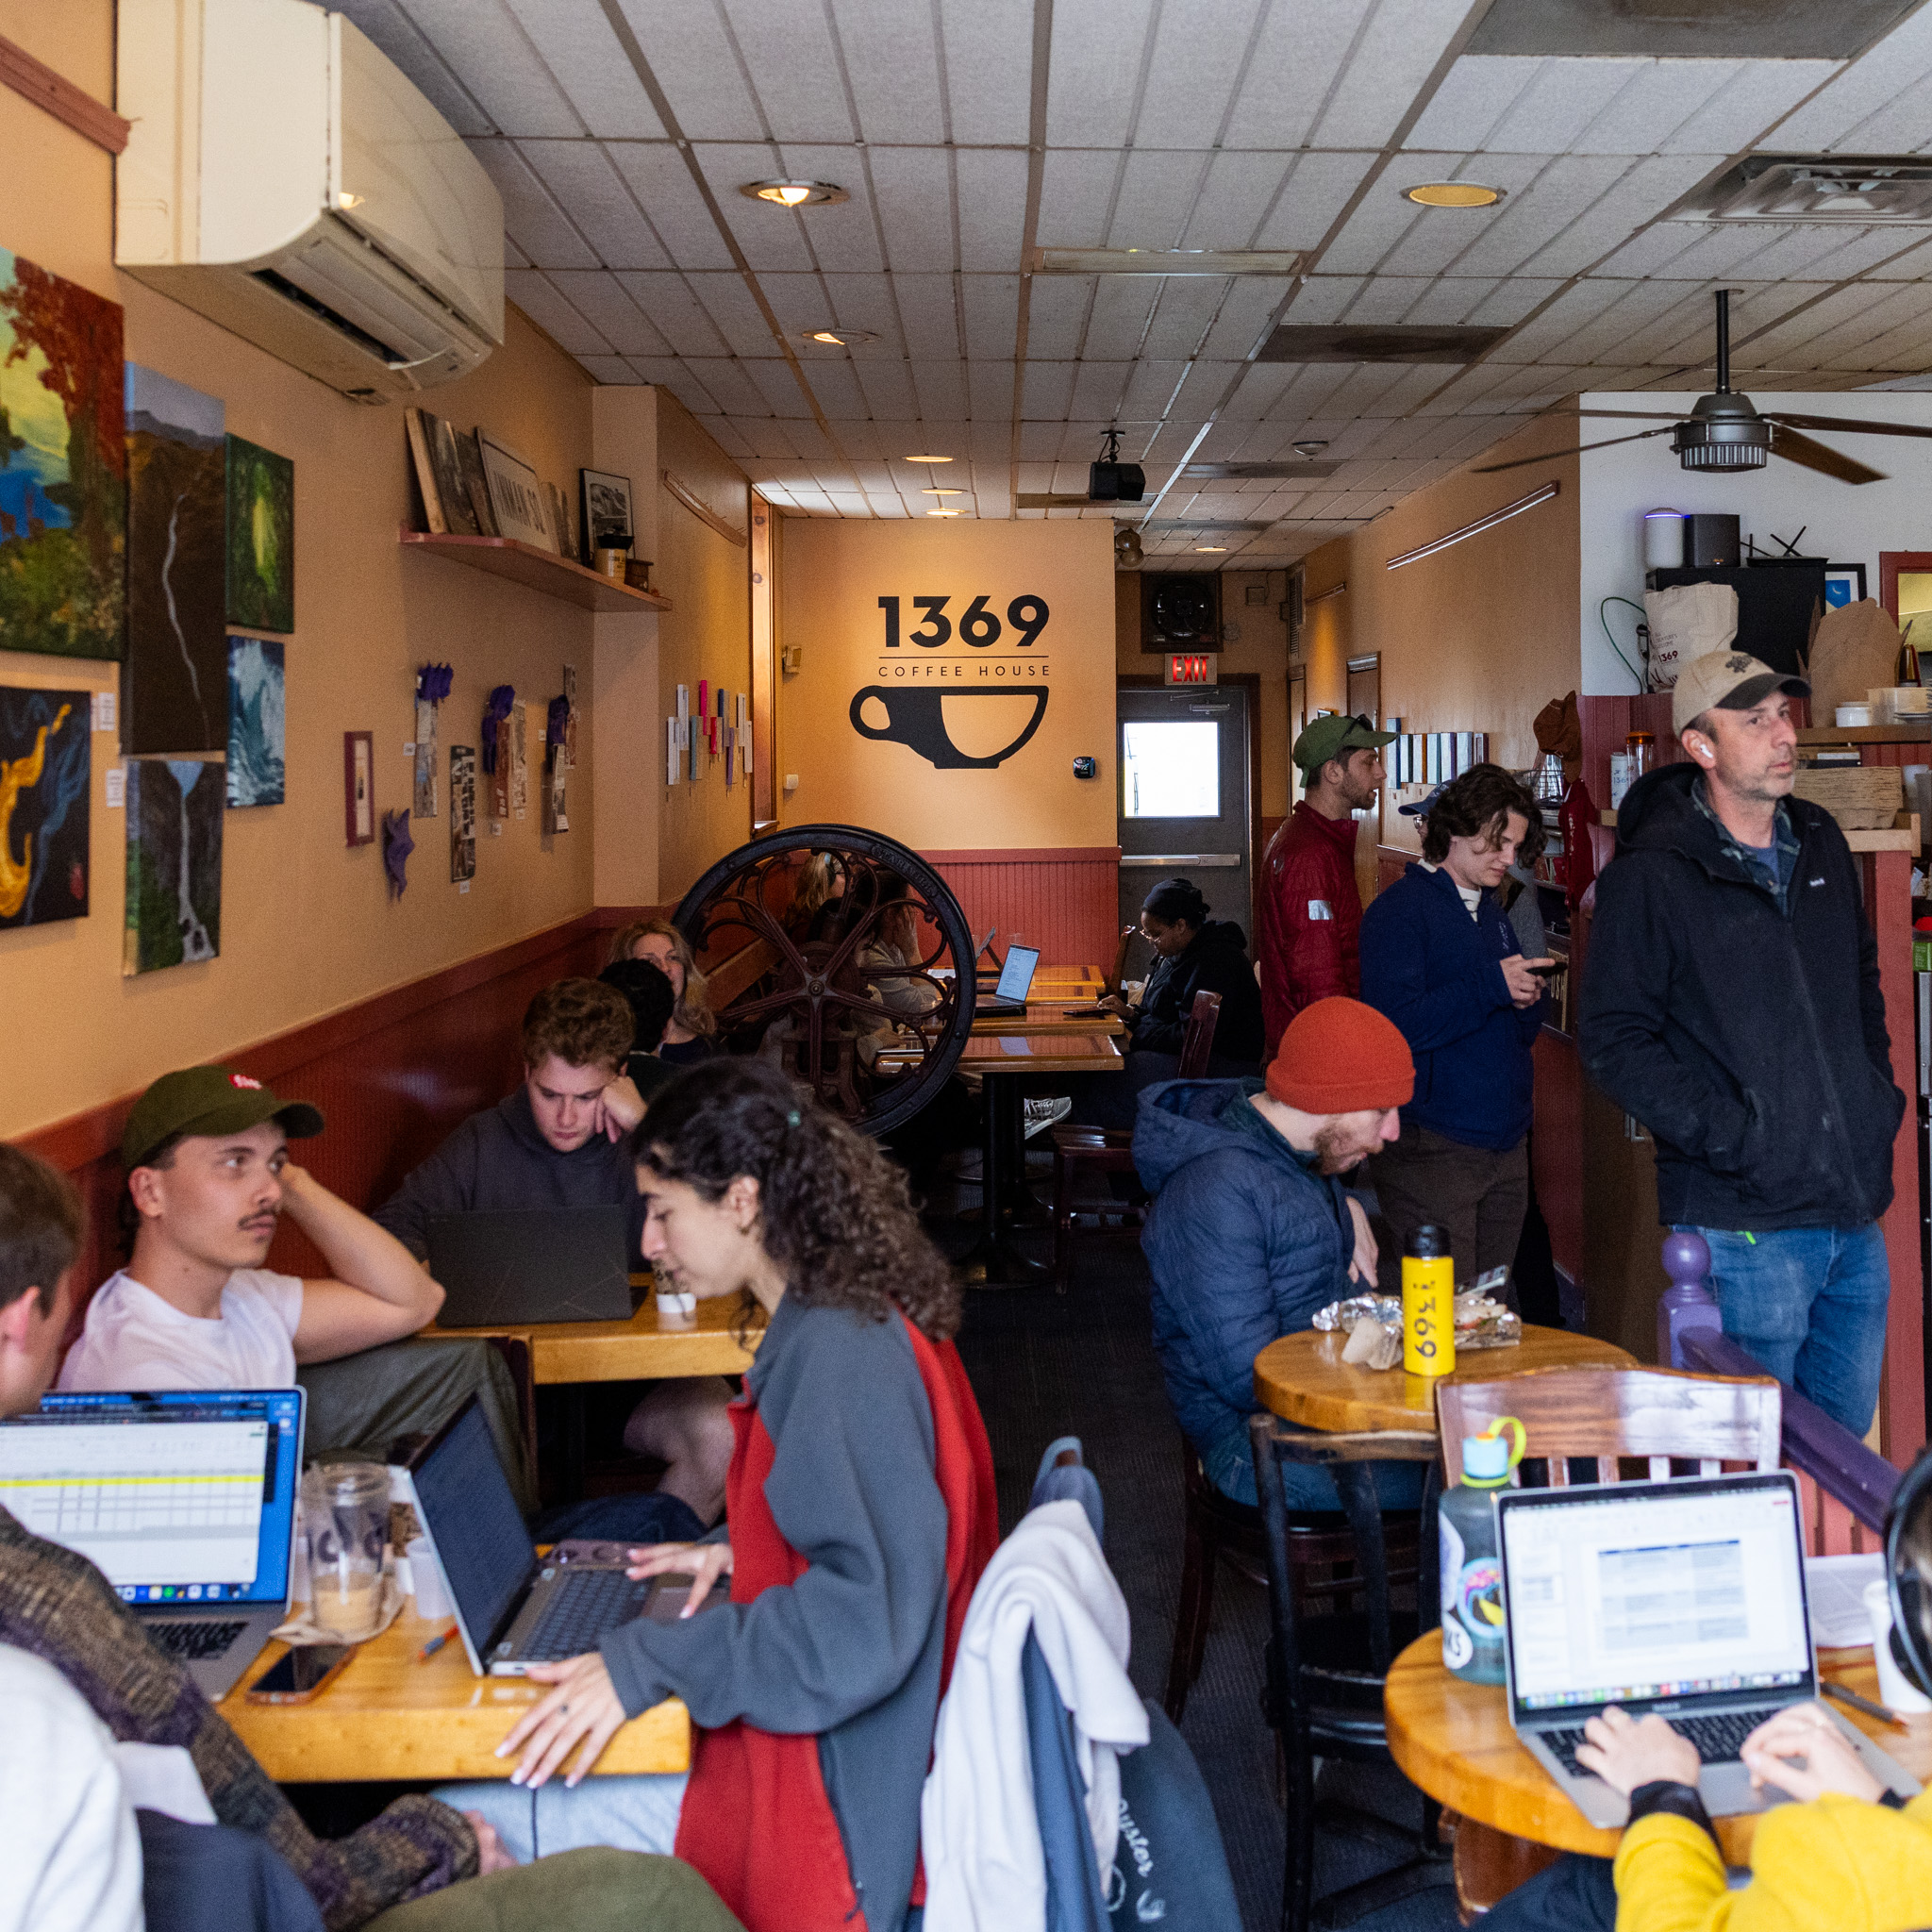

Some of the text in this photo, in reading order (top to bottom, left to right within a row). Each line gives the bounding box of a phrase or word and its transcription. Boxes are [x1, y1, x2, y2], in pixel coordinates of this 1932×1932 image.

[877, 593, 1050, 648] 1369
[1657, 650, 1678, 663] 1369
[878, 665, 1050, 677] COFFEE HOUSE
[1173, 656, 1209, 682] EXIT
